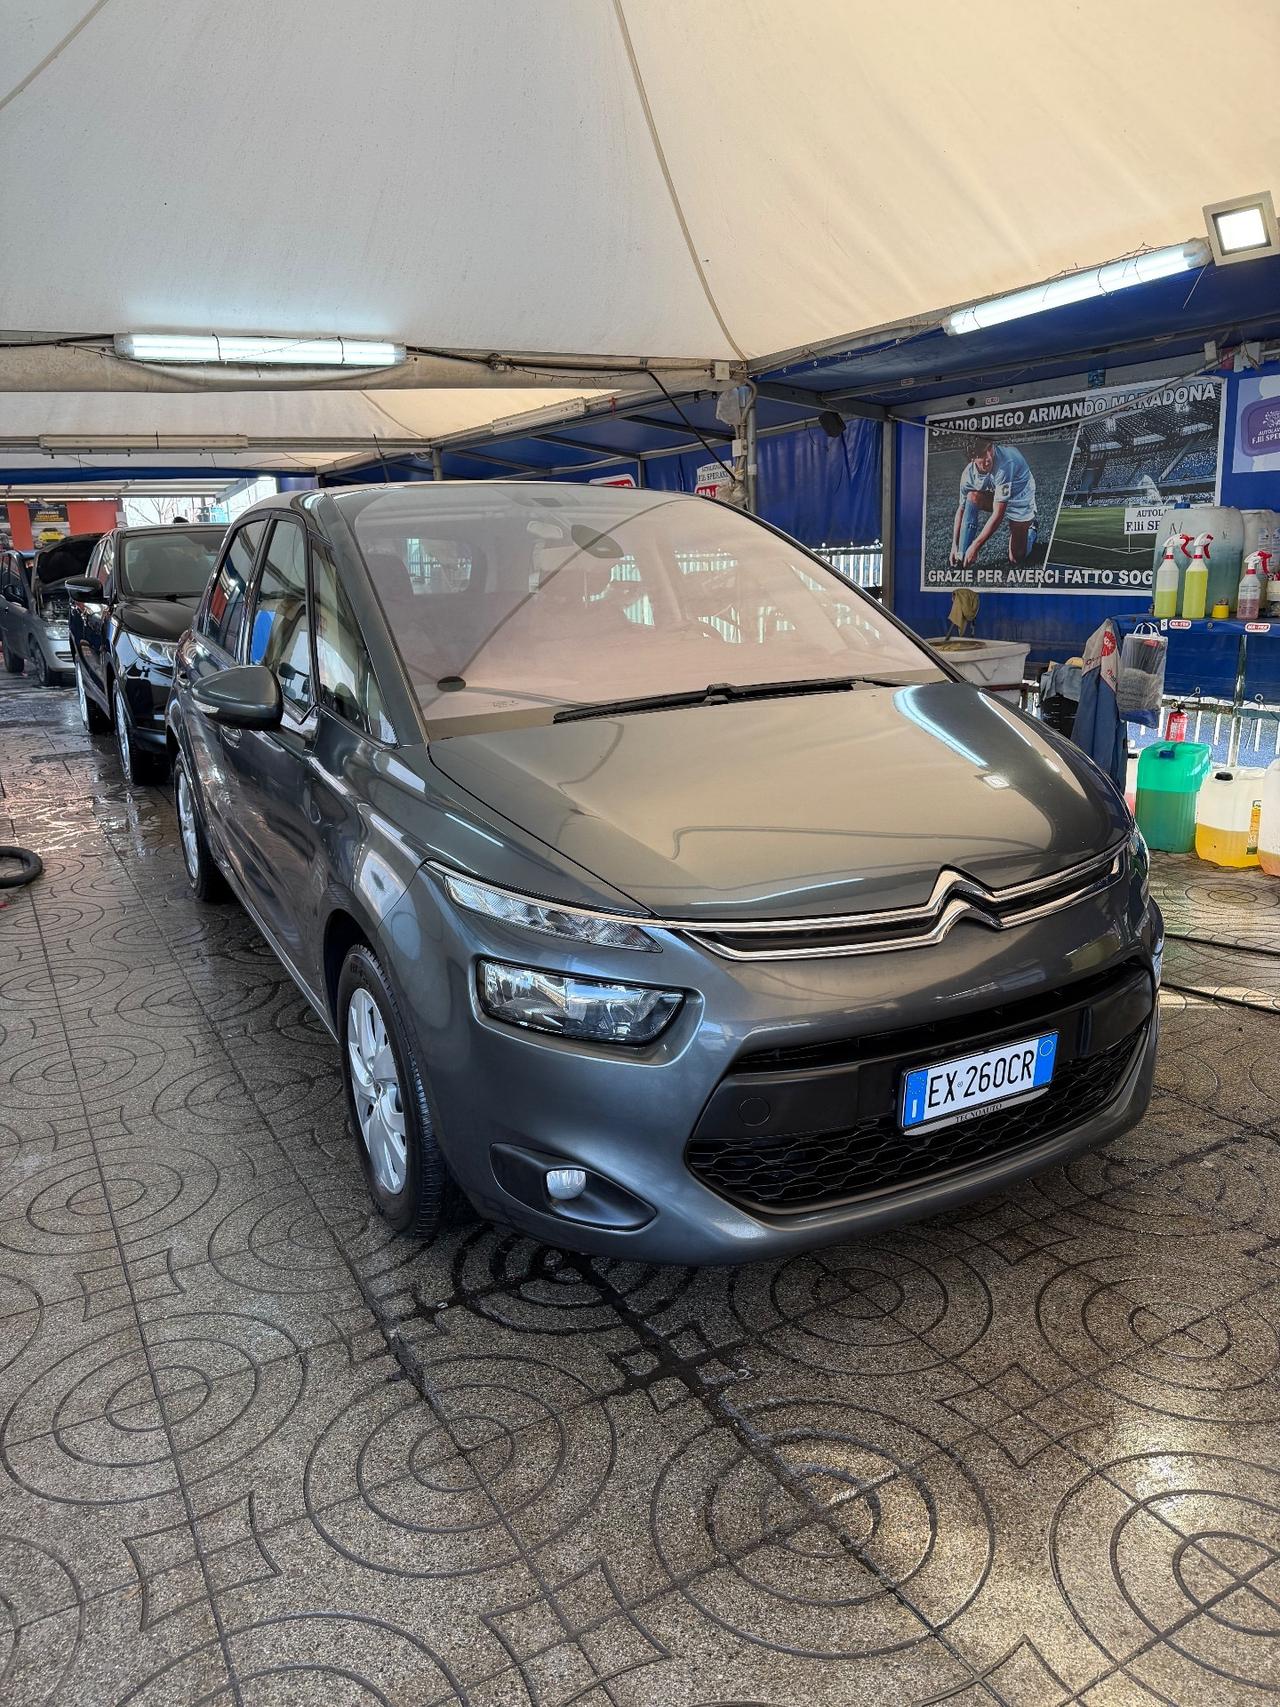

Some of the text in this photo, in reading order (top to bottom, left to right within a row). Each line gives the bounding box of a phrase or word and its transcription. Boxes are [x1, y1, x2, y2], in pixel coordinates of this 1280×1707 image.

[981, 411, 1025, 430] DIEGO
[1028, 396, 1107, 424] ARMANDO
[928, 569, 973, 583] GRAZIE
[976, 569, 1003, 583] PER
[1006, 569, 1060, 584] AVERCI
[1064, 569, 1113, 584] FATTO
[955, 1103, 1002, 1123] TECNOAUTO
